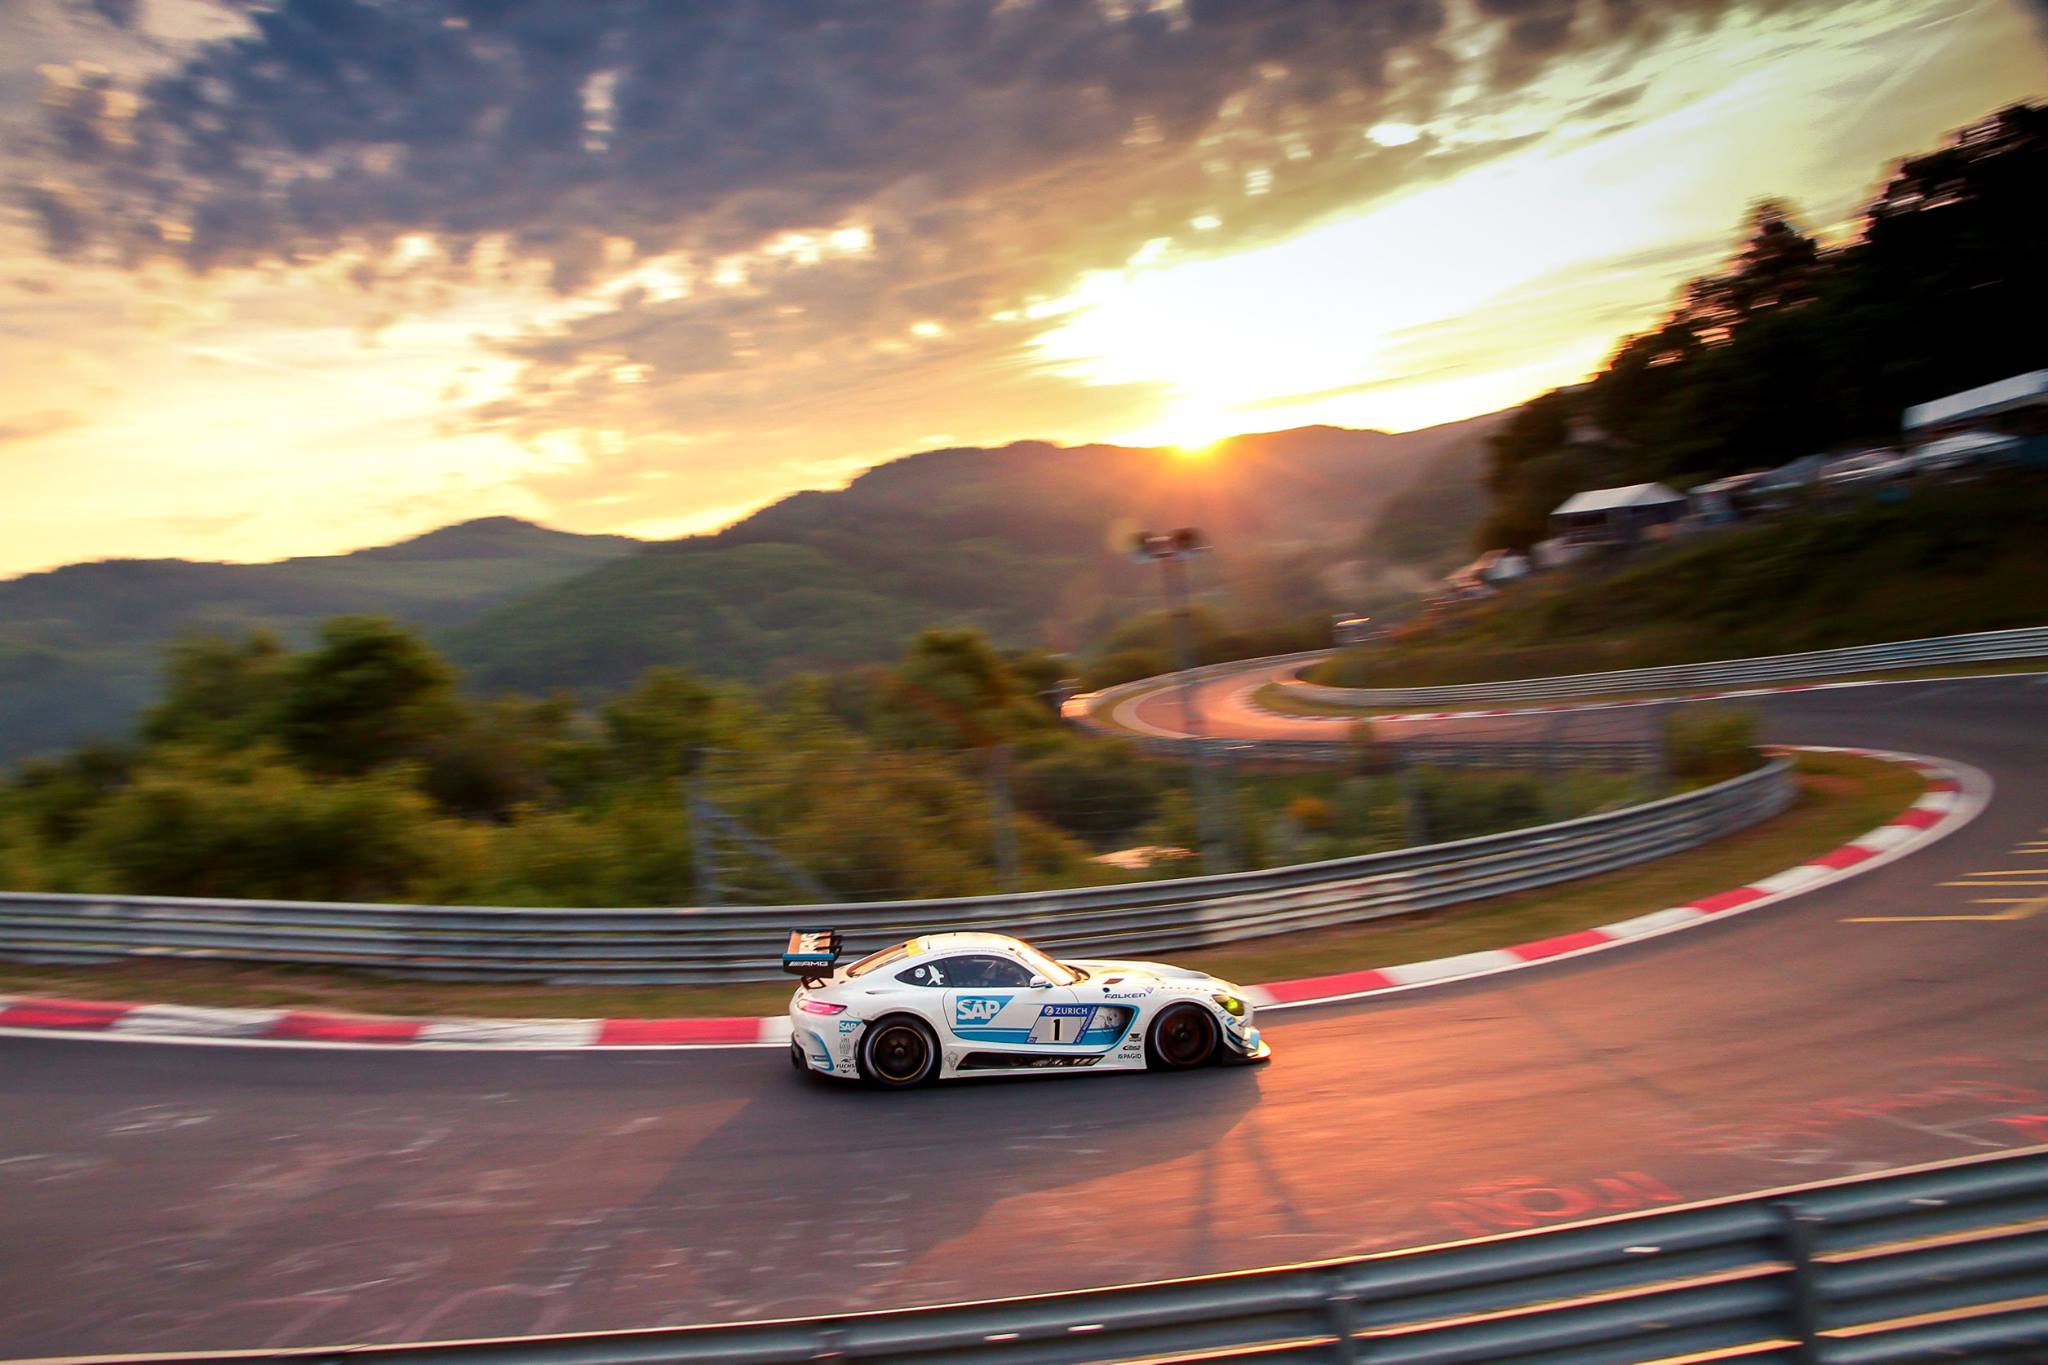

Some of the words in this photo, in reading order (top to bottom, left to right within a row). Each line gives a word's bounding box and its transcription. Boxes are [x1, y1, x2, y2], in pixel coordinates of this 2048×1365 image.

[957, 1000, 1001, 1020] SAP
[1055, 1007, 1088, 1015] ZURICH
[840, 1022, 857, 1031] SAP
[1053, 1019, 1061, 1041] 1
